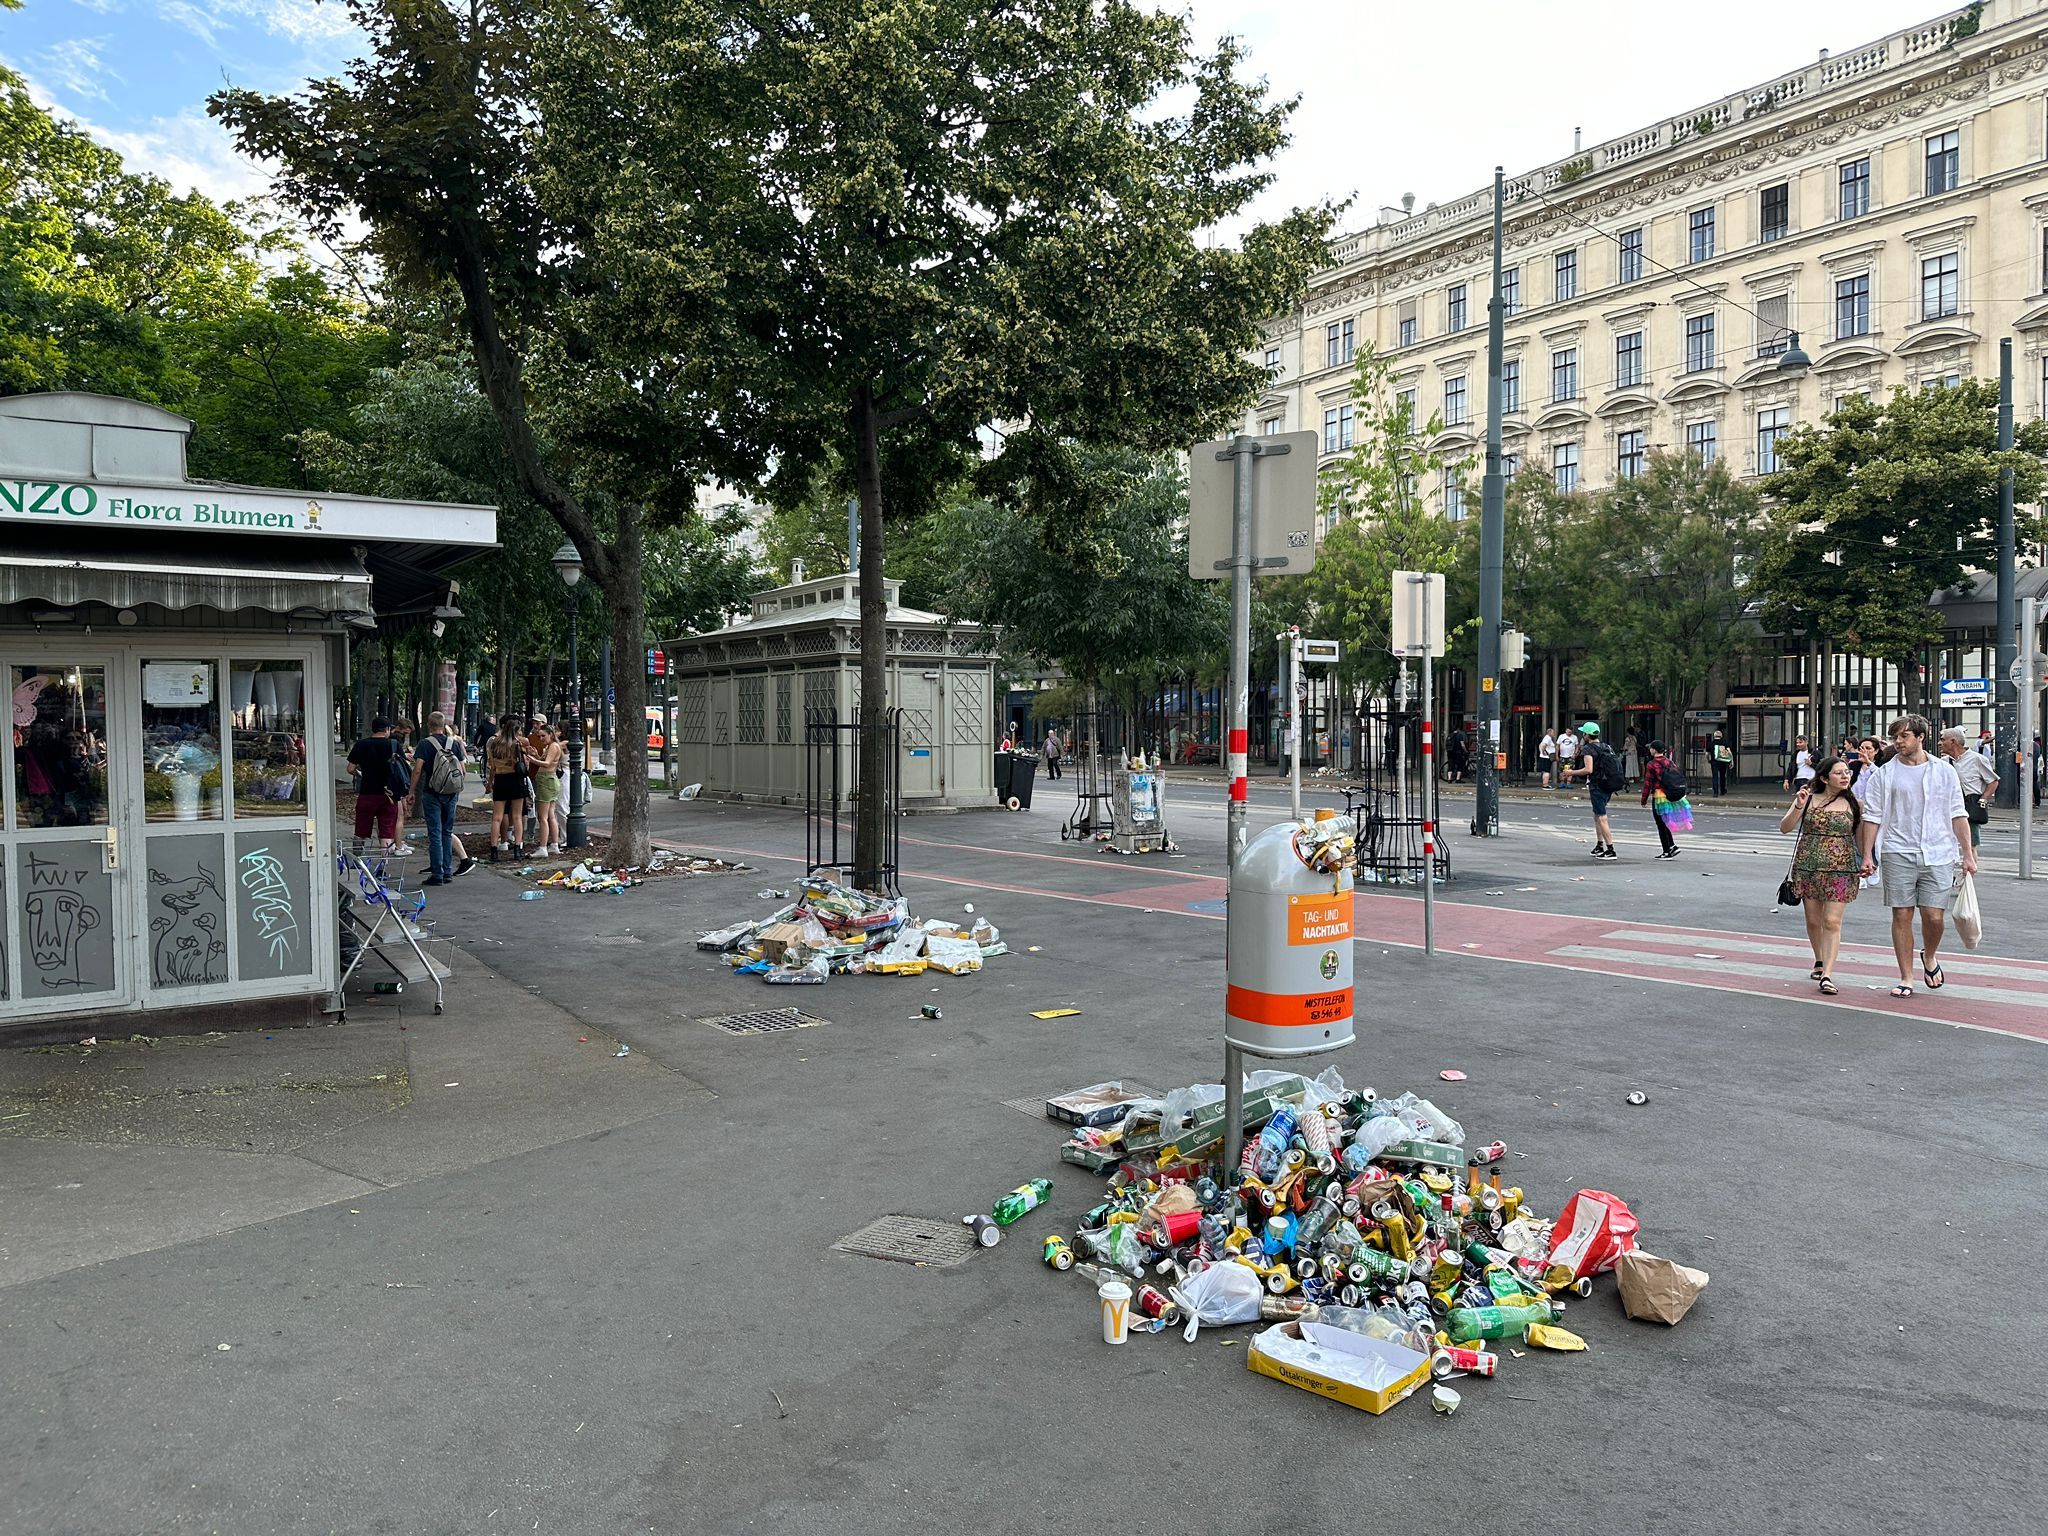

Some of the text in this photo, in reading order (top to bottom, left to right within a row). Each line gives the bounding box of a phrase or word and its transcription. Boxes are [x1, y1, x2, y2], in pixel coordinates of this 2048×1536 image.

[108, 498, 182, 522] Flora
[193, 503, 294, 528] Blumen
[1303, 908, 1339, 923] TAG- UND
[1304, 994, 1345, 1008] MISTTELEFON
[1279, 1366, 1323, 1390] Ottakringer
